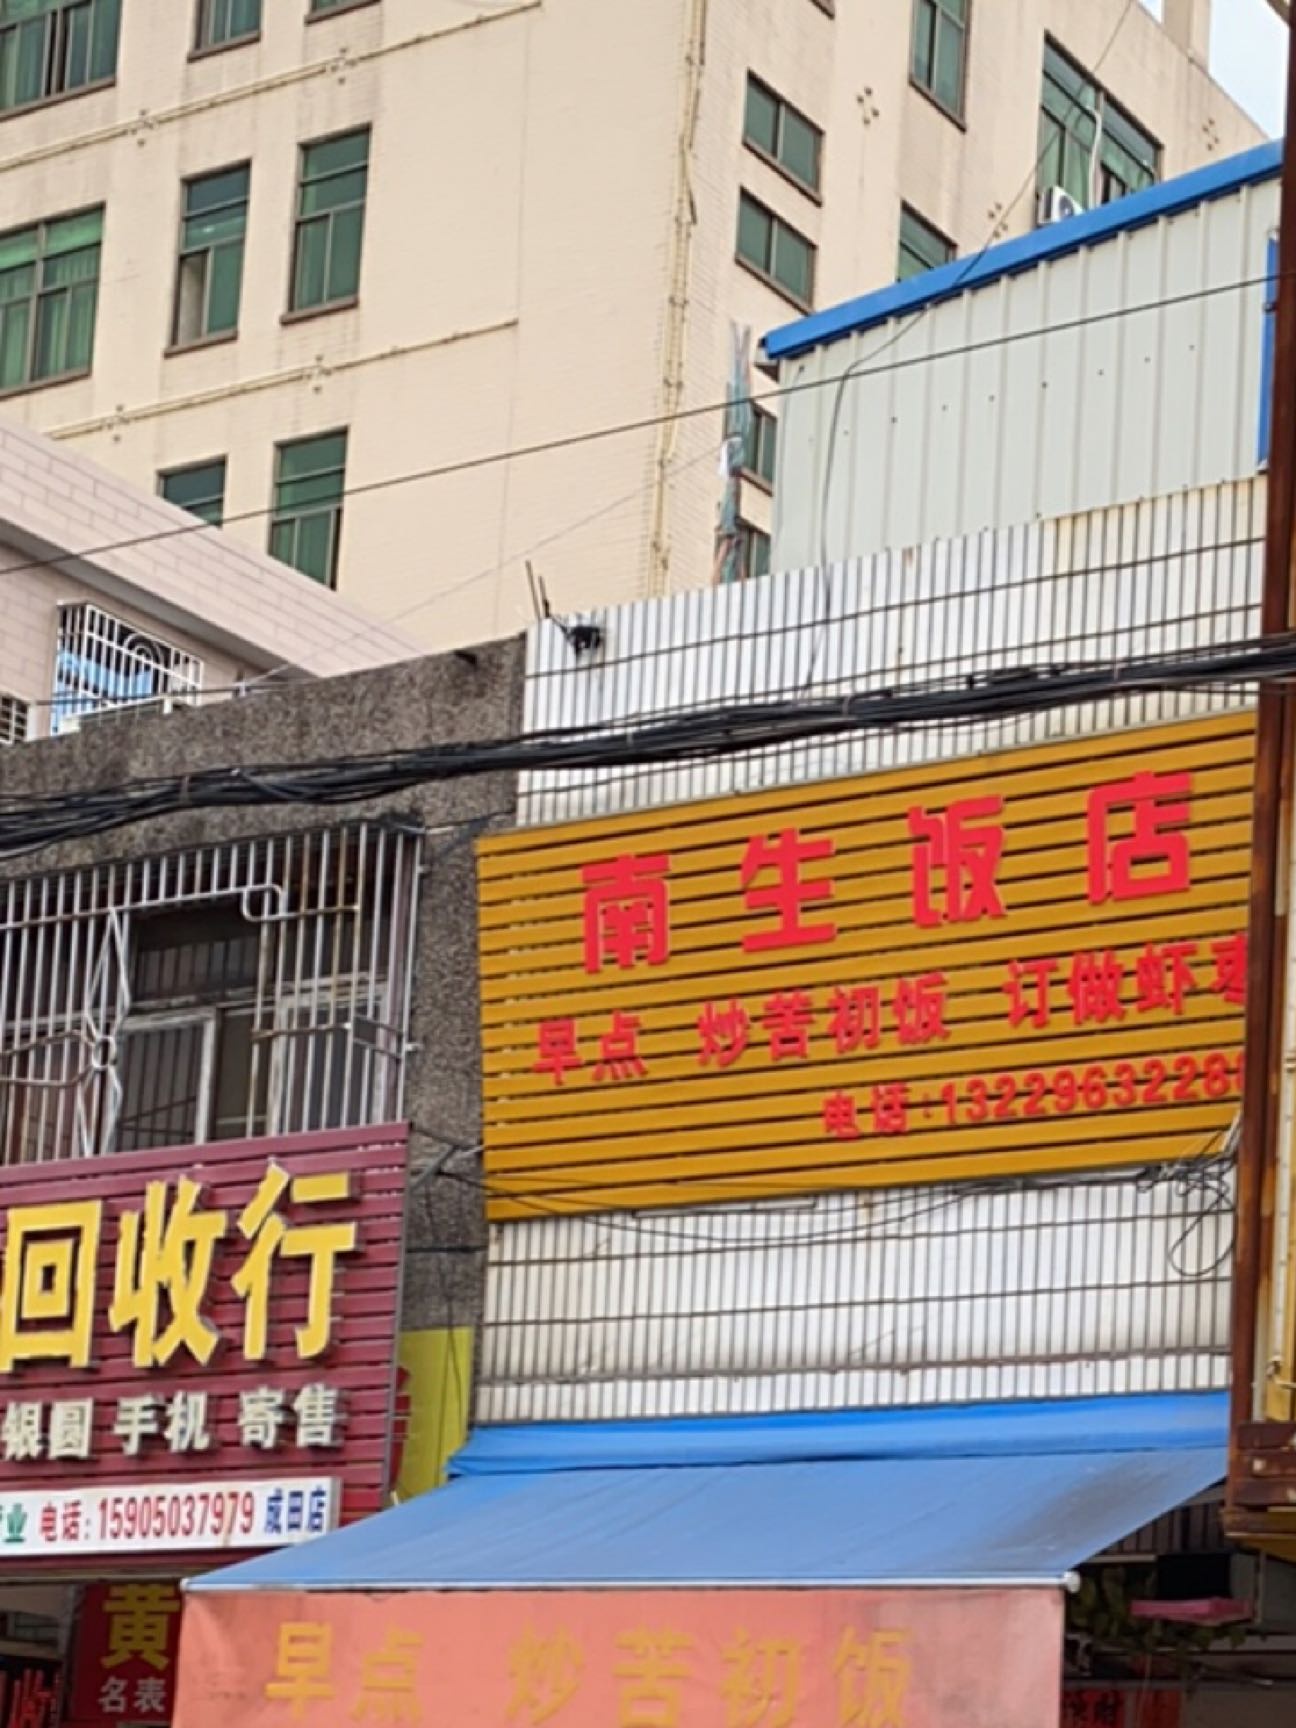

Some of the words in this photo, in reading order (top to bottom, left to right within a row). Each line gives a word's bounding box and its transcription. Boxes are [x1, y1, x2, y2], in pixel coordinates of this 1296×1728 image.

[579, 770, 1194, 975] 南生饭店
[533, 1008, 648, 1087] 早点
[0, 1158, 358, 1374] 回收行
[113, 1390, 211, 1456] 手机
[238, 1382, 342, 1450] 寄售
[98, 1675, 167, 1714] 名表
[263, 1620, 426, 1726] 早点
